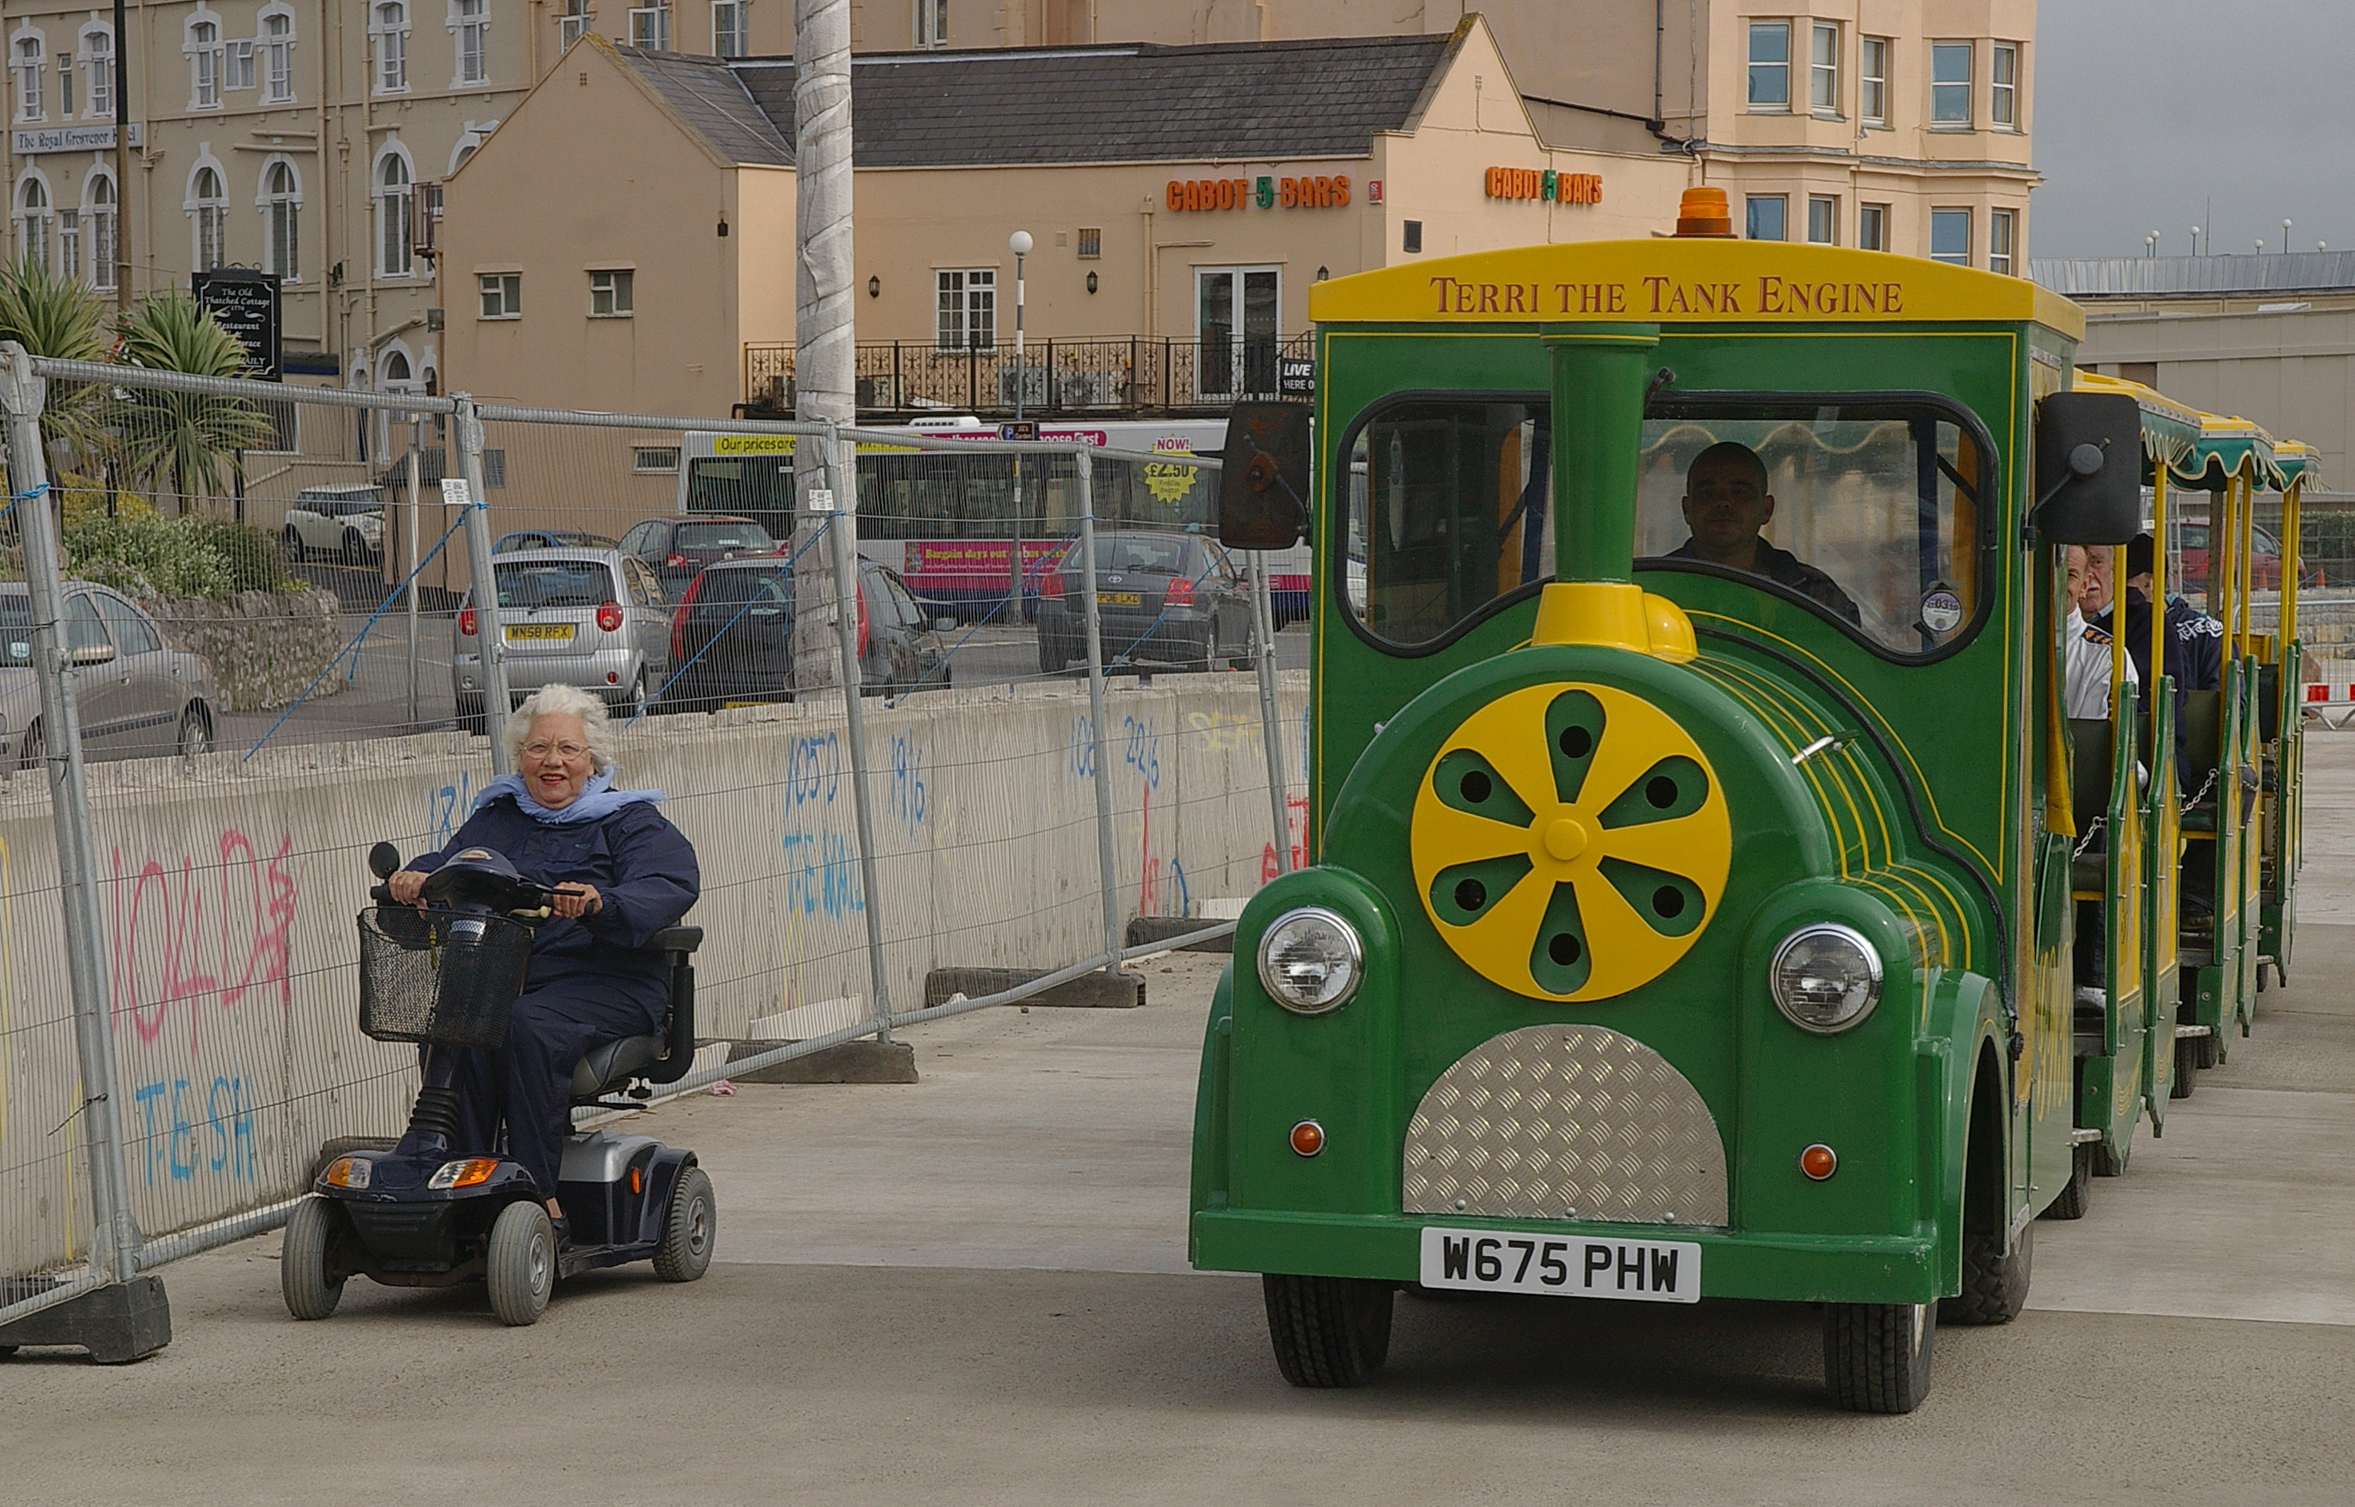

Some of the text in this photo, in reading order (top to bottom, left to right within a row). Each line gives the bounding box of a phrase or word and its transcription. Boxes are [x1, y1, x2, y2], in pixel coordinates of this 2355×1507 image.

[19, 126, 136, 150] The Royal Grosvenor Hel
[1484, 165, 1603, 204] CABOT 5 BARS
[1165, 178, 1248, 212] CABOT
[1255, 176, 1274, 209] 5
[1279, 174, 1351, 208] BARS
[222, 287, 254, 297] The Old
[204, 296, 271, 309] Thatched Cottage
[216, 321, 260, 331] Restaurant
[1283, 363, 1312, 377] LIVE
[1283, 379, 1315, 390] HERE O
[721, 438, 796, 452] Our prices are
[1157, 439, 1190, 450] NOW!
[1150, 463, 1190, 478] £2.50
[965, 549, 987, 560] days
[990, 550, 1006, 558] out
[1443, 1236, 1679, 1293] W675 PHW
